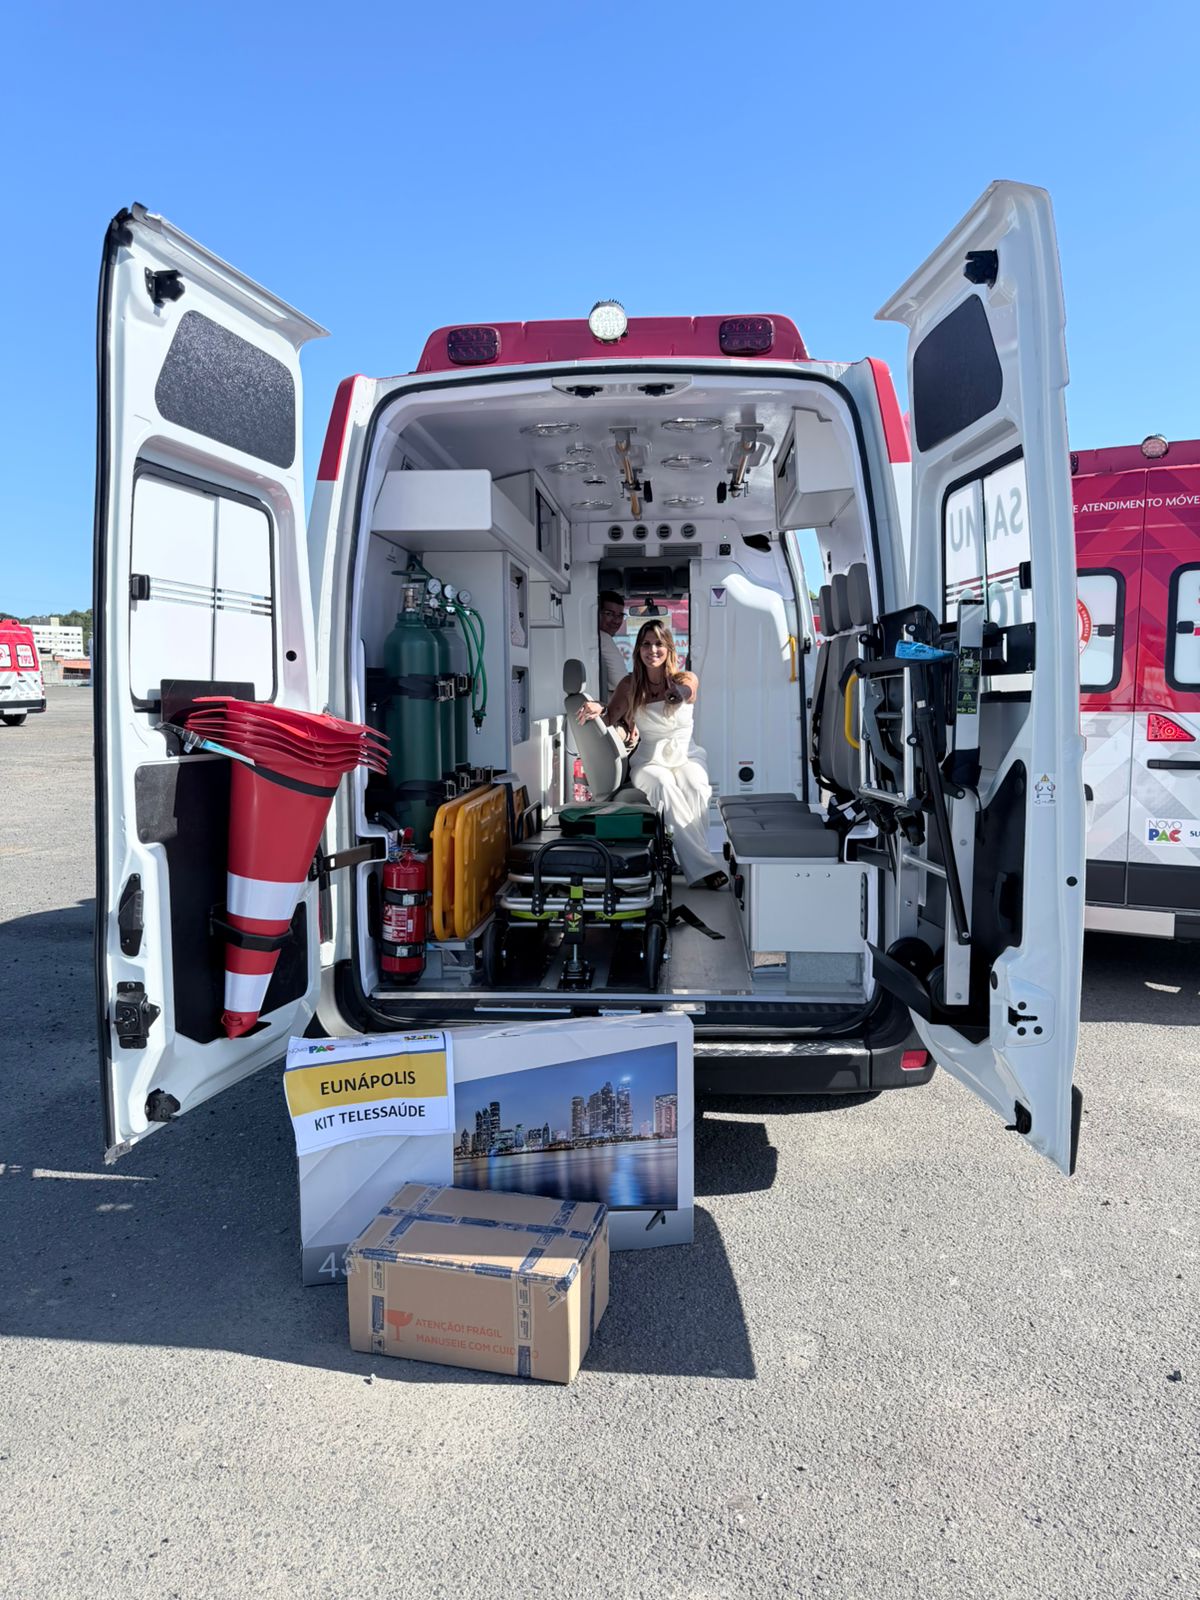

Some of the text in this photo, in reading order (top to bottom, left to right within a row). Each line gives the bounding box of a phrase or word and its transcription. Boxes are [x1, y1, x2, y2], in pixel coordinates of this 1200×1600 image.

[1080, 497, 1162, 513] ATENDIMENTO
[1148, 819, 1183, 829] NOVO
[1148, 828, 1182, 843] PAC
[308, 1044, 336, 1054] PAC
[320, 1070, 416, 1096] EUNÁPOLIS
[314, 1102, 426, 1131] KIT TELESSAÚDE
[416, 1318, 465, 1334] ATENÇÃO!
[467, 1325, 503, 1339] FRÁGIL
[416, 1334, 539, 1360] MANUSEIE COM CUIDO
